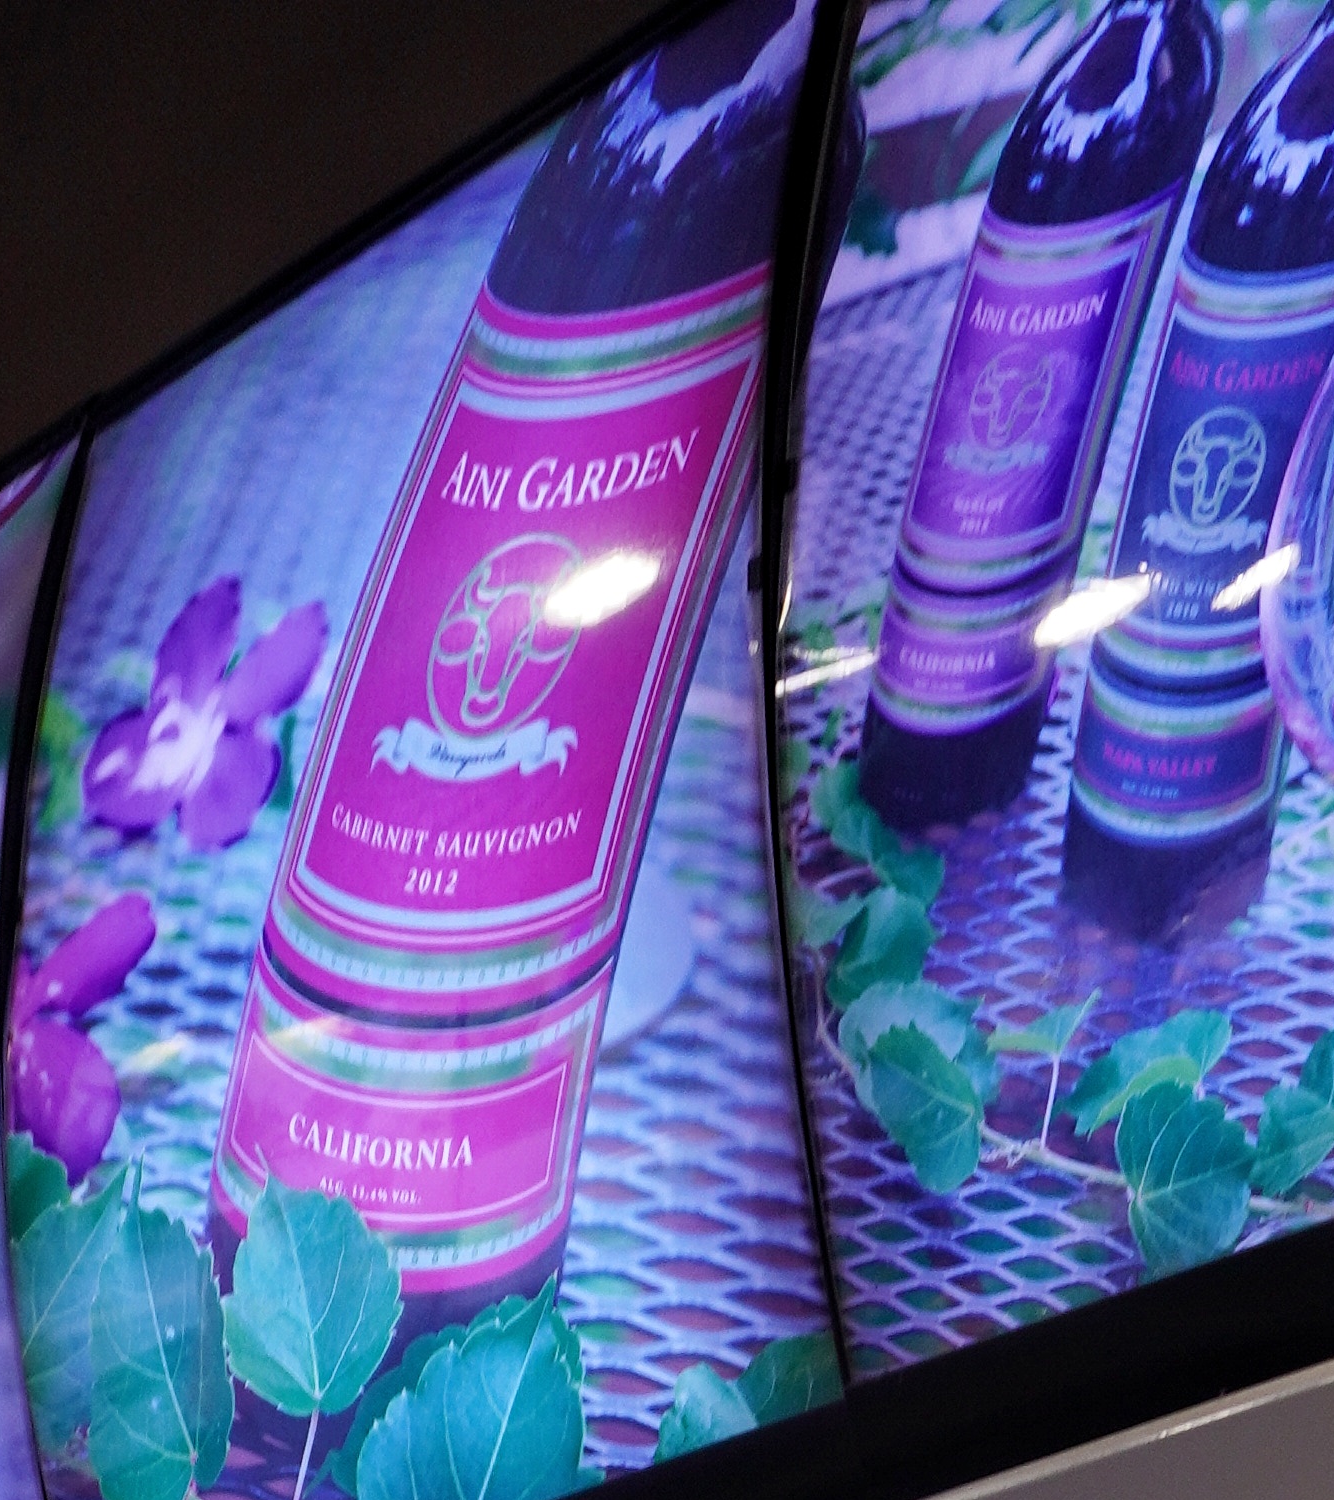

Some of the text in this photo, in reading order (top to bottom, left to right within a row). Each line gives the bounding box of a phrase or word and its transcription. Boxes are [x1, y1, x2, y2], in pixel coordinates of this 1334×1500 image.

[440, 426, 701, 513] AINI GARDEN
[331, 803, 583, 858] CABERNET SAUVIGNON
[404, 867, 459, 896] 2012
[289, 1112, 473, 1170] CALIFORNIA
